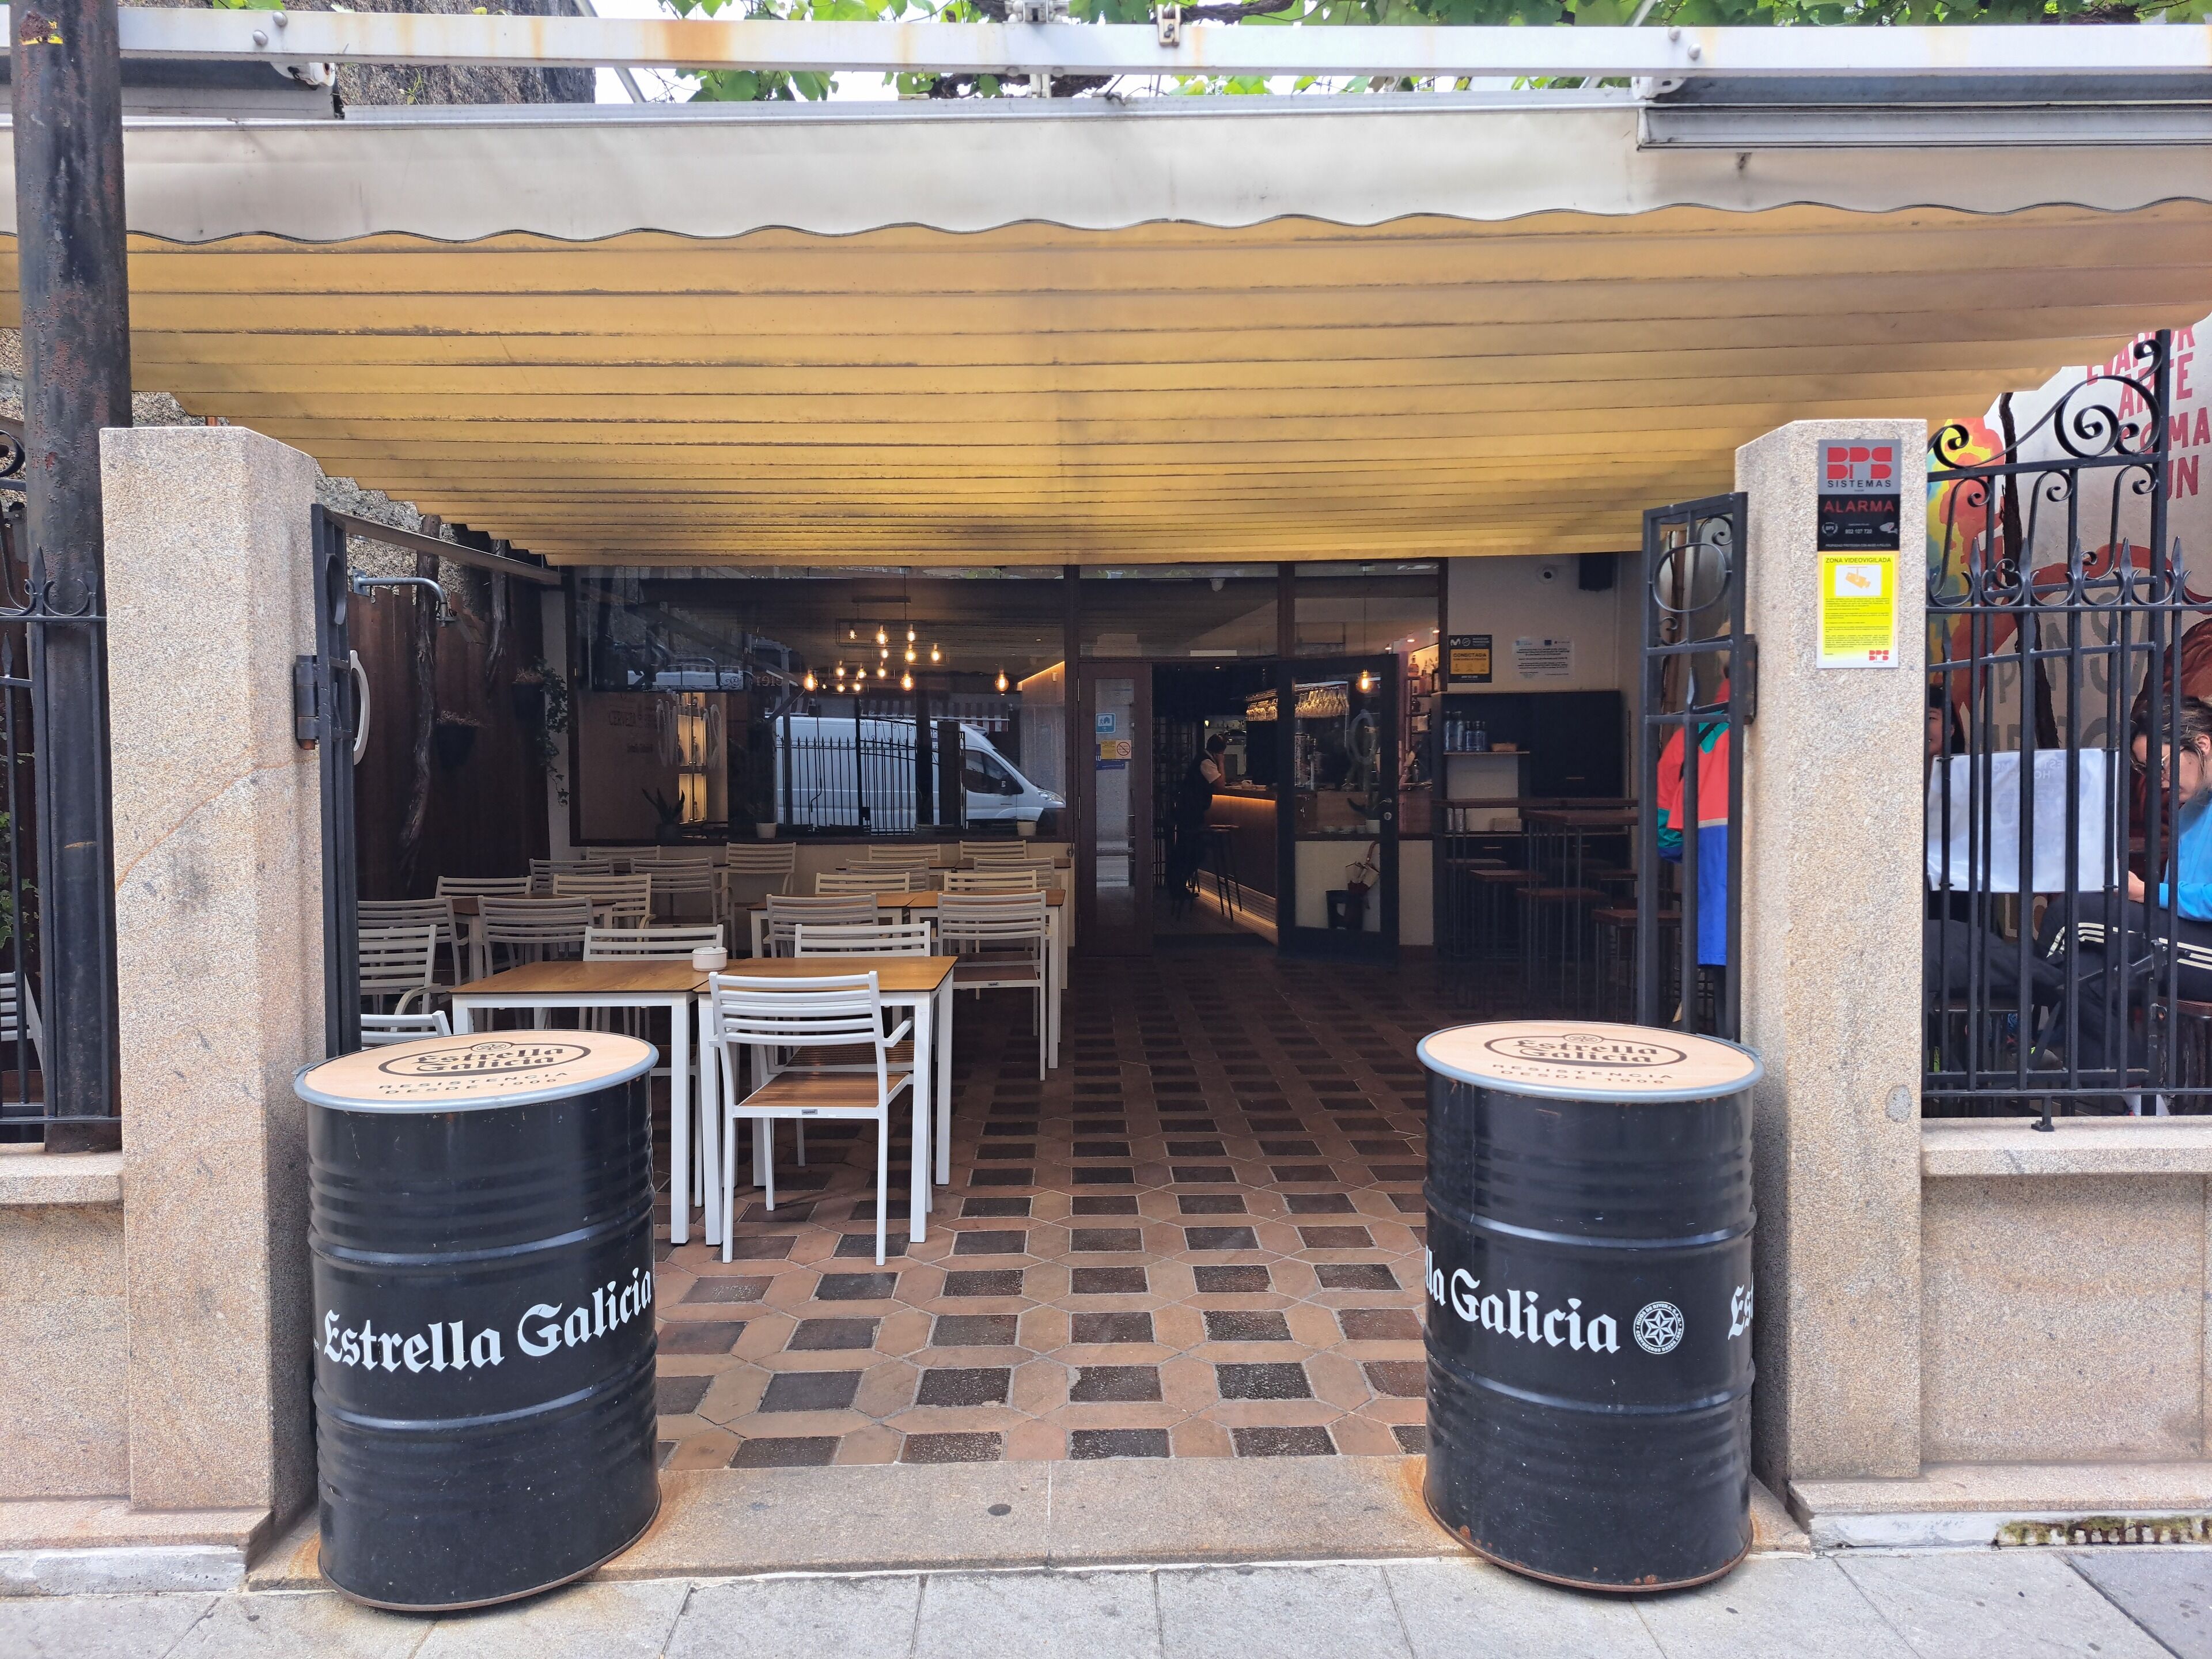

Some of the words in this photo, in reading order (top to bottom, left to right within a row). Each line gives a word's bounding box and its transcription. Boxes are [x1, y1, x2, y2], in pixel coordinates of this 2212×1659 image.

[2118, 352, 2194, 421] ARE
[1827, 480, 1891, 488] SISTEMAS
[1824, 500, 1894, 513] ALARMA
[1512, 1039, 1660, 1055] Estrella
[1520, 1047, 1653, 1063] Galicia
[411, 1048, 566, 1065] Estrella
[416, 1056, 555, 1072] Galicia
[1493, 1065, 1673, 1079] RESISTENCIA
[1501, 1070, 1586, 1081] DESDE
[378, 1072, 568, 1089] RESISTENCIA
[385, 1085, 479, 1094] DESDE
[498, 1078, 557, 1086] 1906
[1450, 1268, 1621, 1354] Galicia
[1636, 1310, 1647, 1325] HIJOS
[324, 1309, 505, 1373] Estrella
[518, 1267, 652, 1357] Galicia
[1635, 1330, 1661, 1353] CERVECEROS
[1661, 1340, 1677, 1351] DESDE
